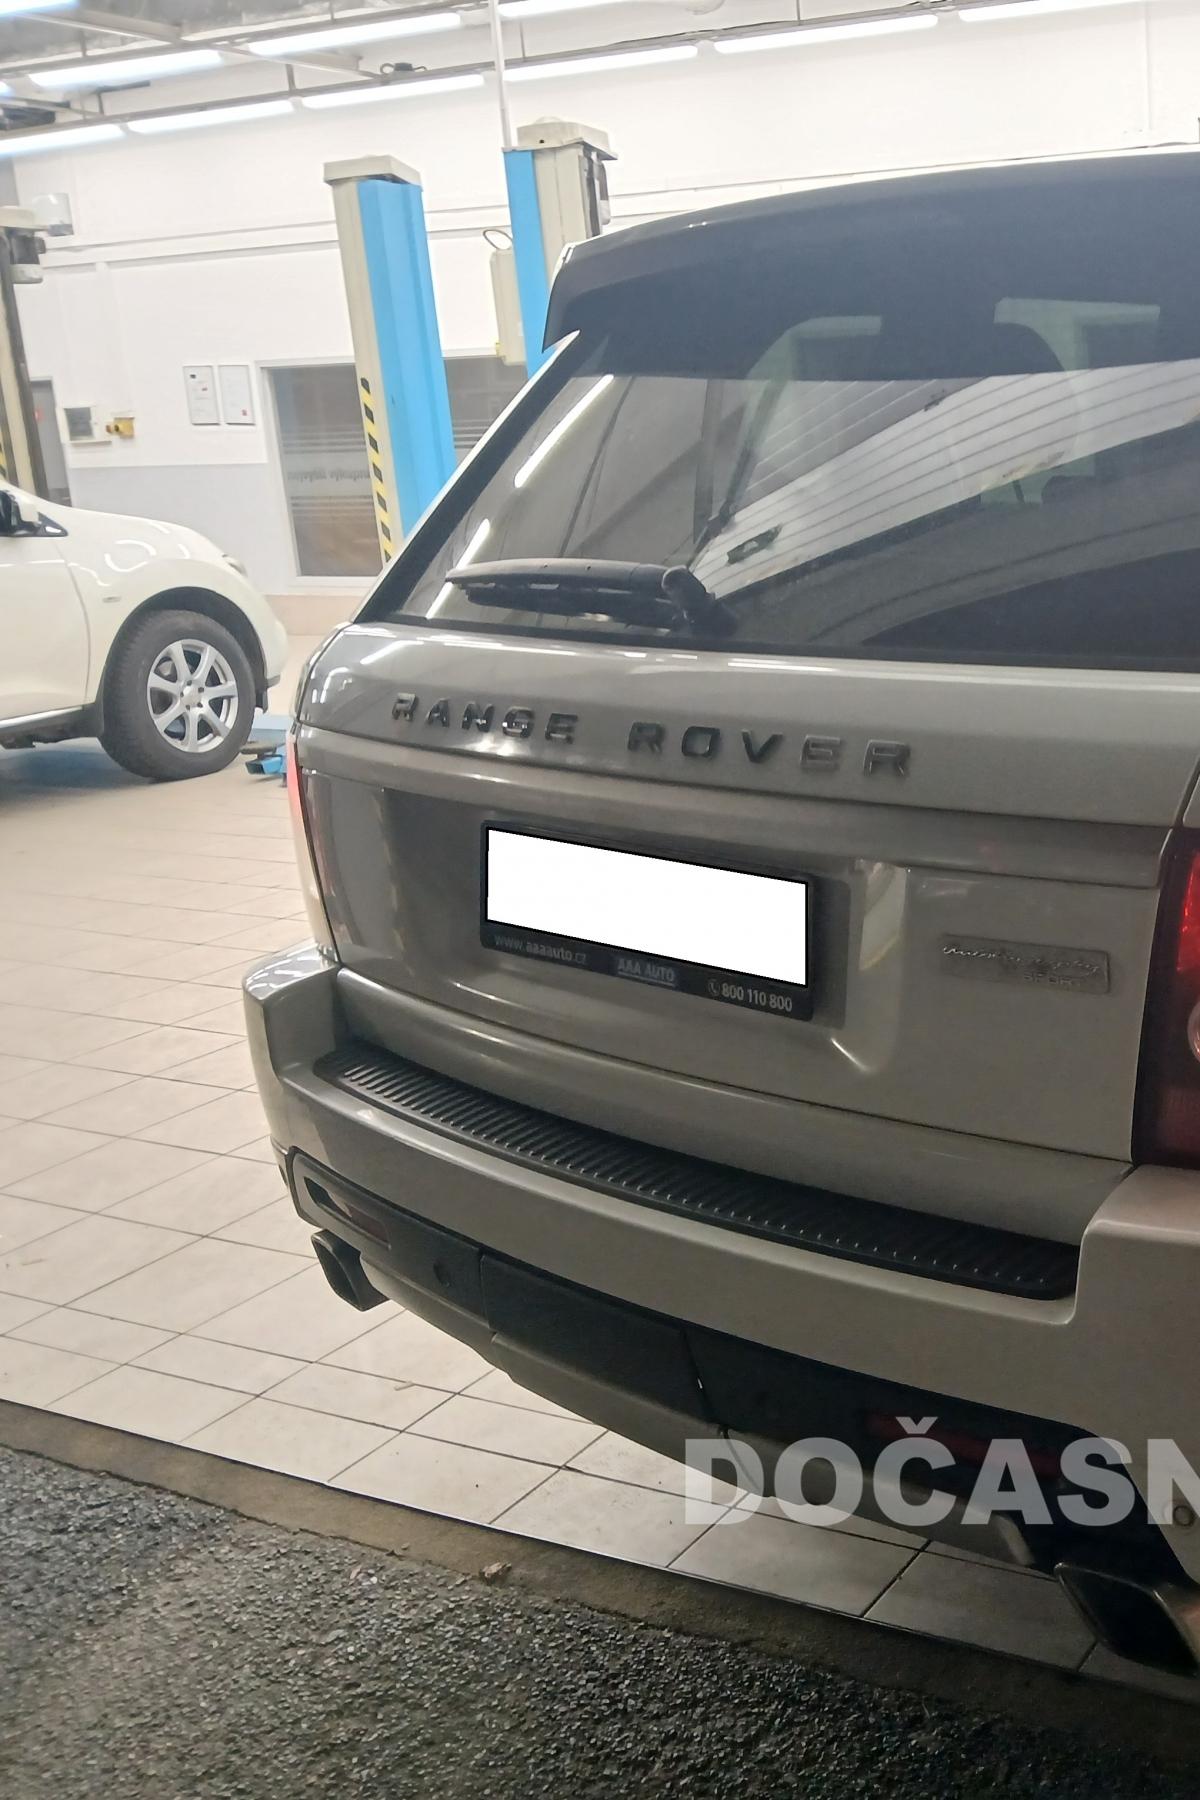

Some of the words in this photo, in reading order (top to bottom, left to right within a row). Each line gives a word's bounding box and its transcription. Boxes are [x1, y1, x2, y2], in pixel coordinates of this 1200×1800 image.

[391, 691, 578, 745] RANGE
[626, 720, 912, 779] ROVER
[617, 957, 642, 975] AAA
[645, 963, 676, 982] AUTO
[721, 982, 745, 1001] 800
[747, 988, 767, 1007] 110
[768, 993, 794, 1012] 800
